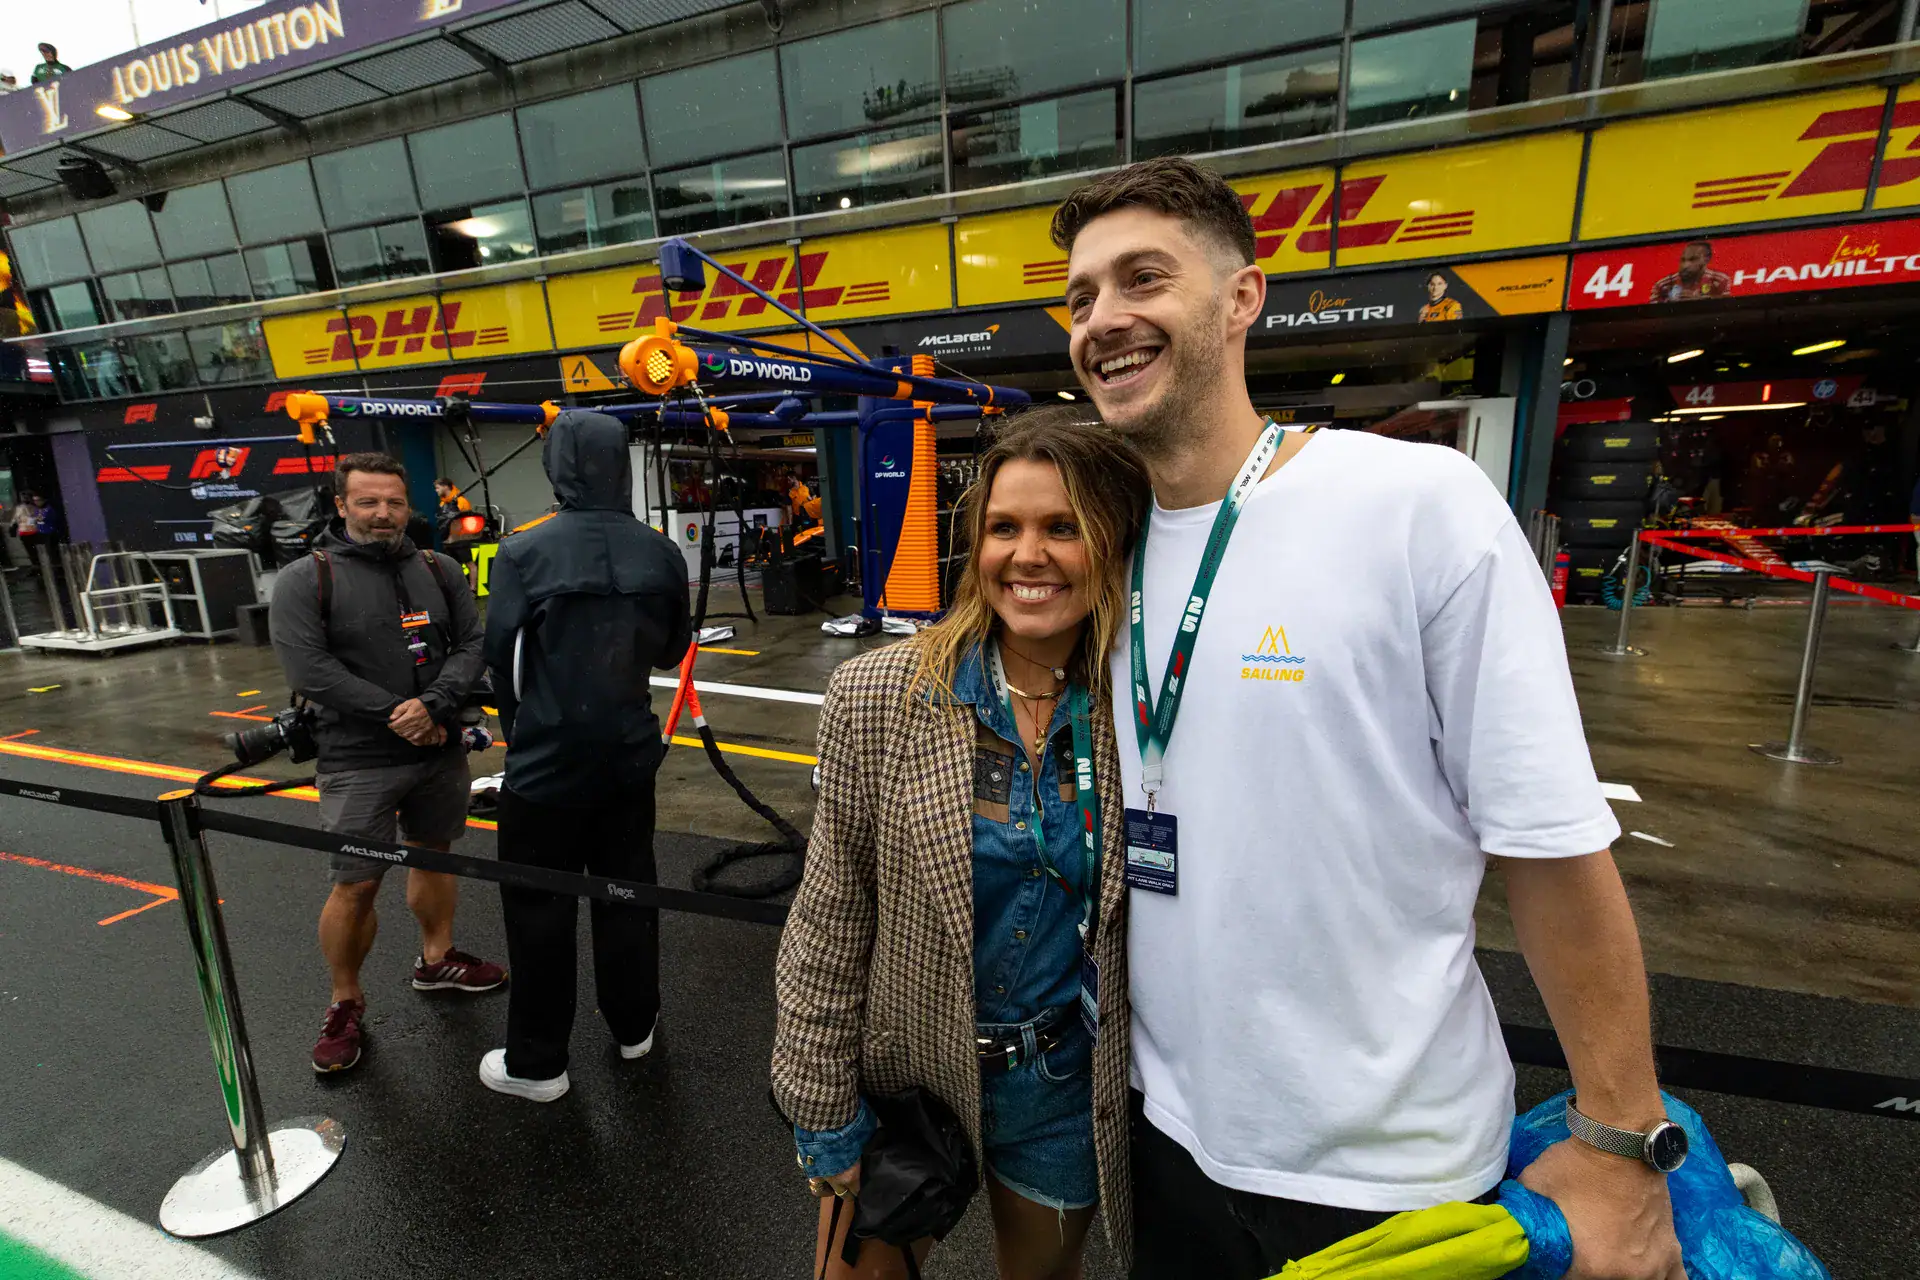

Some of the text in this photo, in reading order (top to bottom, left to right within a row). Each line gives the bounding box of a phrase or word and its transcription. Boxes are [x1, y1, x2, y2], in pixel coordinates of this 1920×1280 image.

[113, 0, 345, 104] LOUIS VUITTON
[1240, 174, 1406, 259] HL
[1830, 235, 1881, 266] Lewis
[632, 251, 846, 328] DHL
[1496, 282, 1548, 292] McLaren
[1583, 263, 1634, 300] 44
[1309, 290, 1353, 313] Oscar
[1266, 304, 1394, 328] PIASTRI
[326, 301, 477, 362] DHL
[918, 331, 991, 347] McLaren
[571, 361, 590, 386] 4
[730, 359, 812, 382] DP WORLD
[1685, 385, 1716, 405] 44
[361, 402, 387, 415] DP
[1241, 667, 1305, 682] SAILING
[19, 788, 60, 802] McLaren
[340, 844, 403, 863] McLaren
